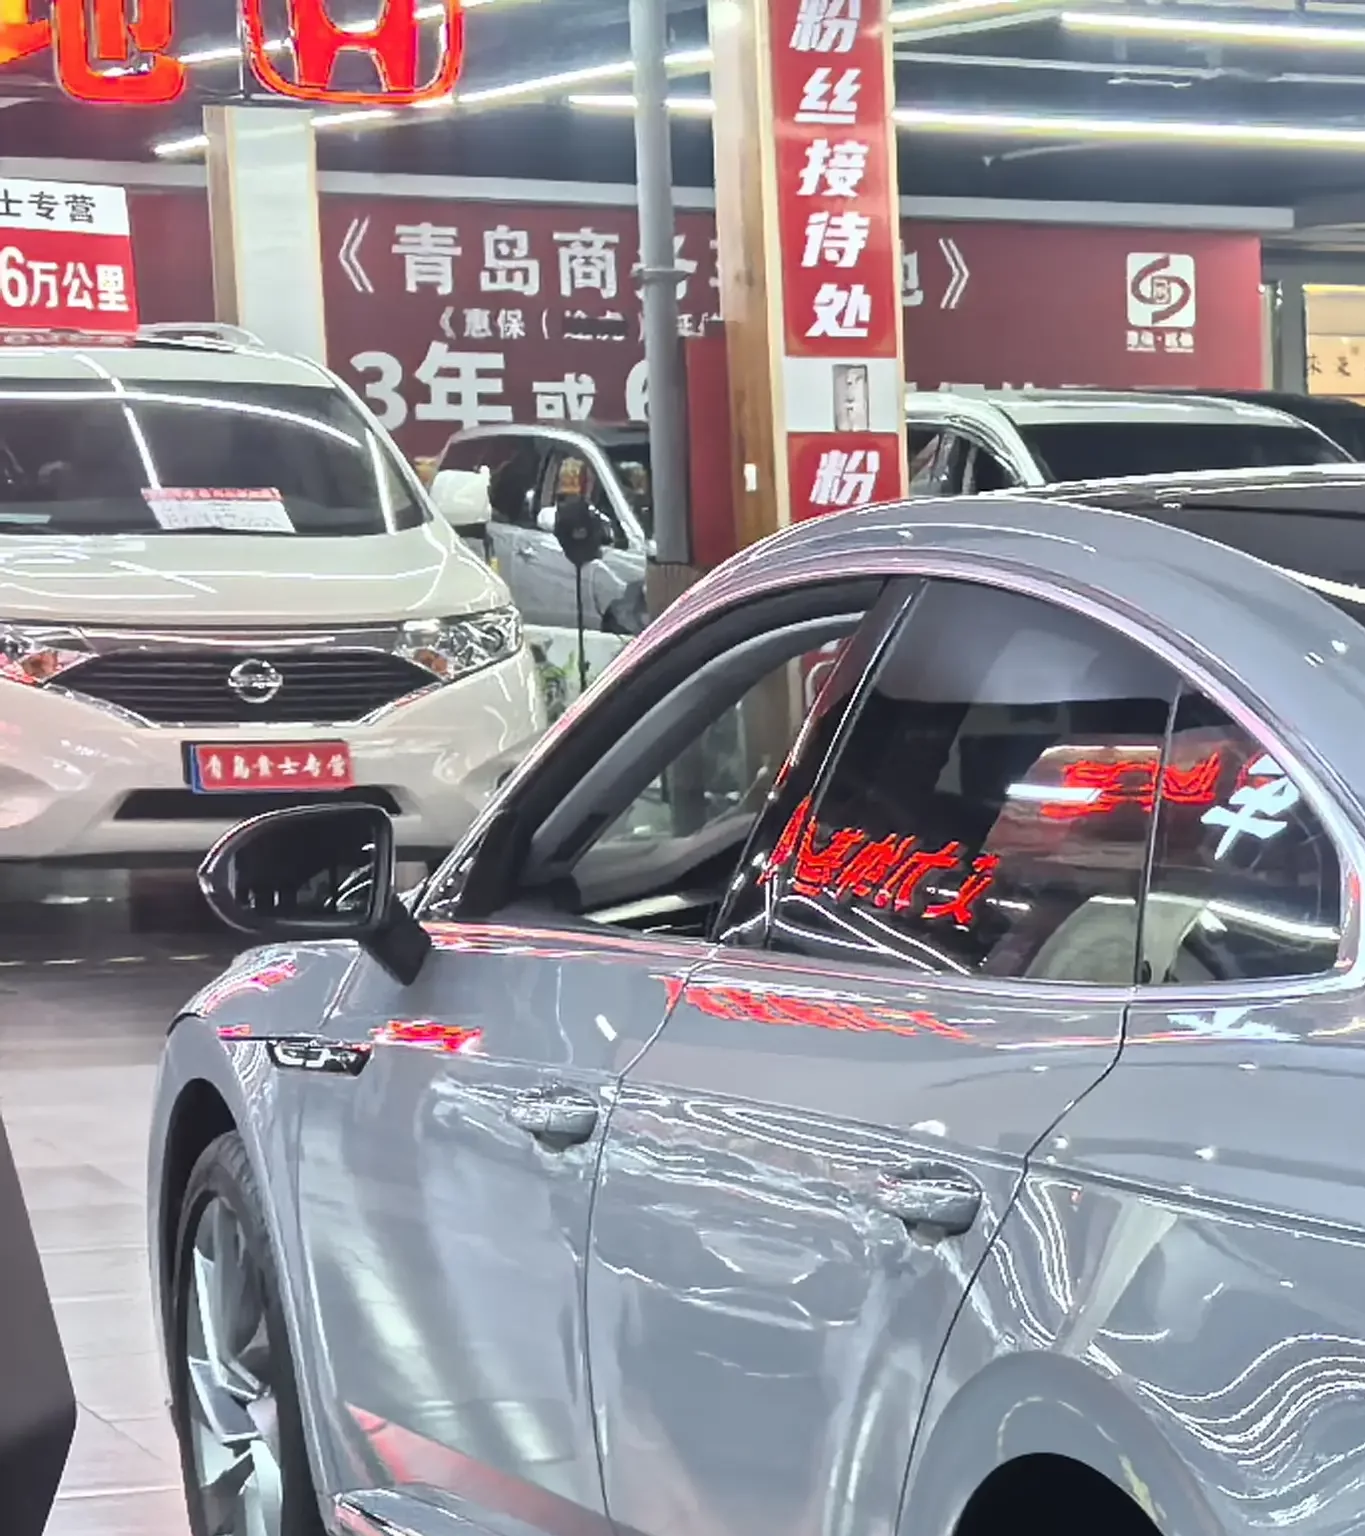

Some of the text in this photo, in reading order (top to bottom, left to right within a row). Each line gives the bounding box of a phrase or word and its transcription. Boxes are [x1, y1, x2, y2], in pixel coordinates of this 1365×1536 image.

[789, 0, 874, 339] 粉丝接待处
[0, 246, 130, 312] 6万公里
